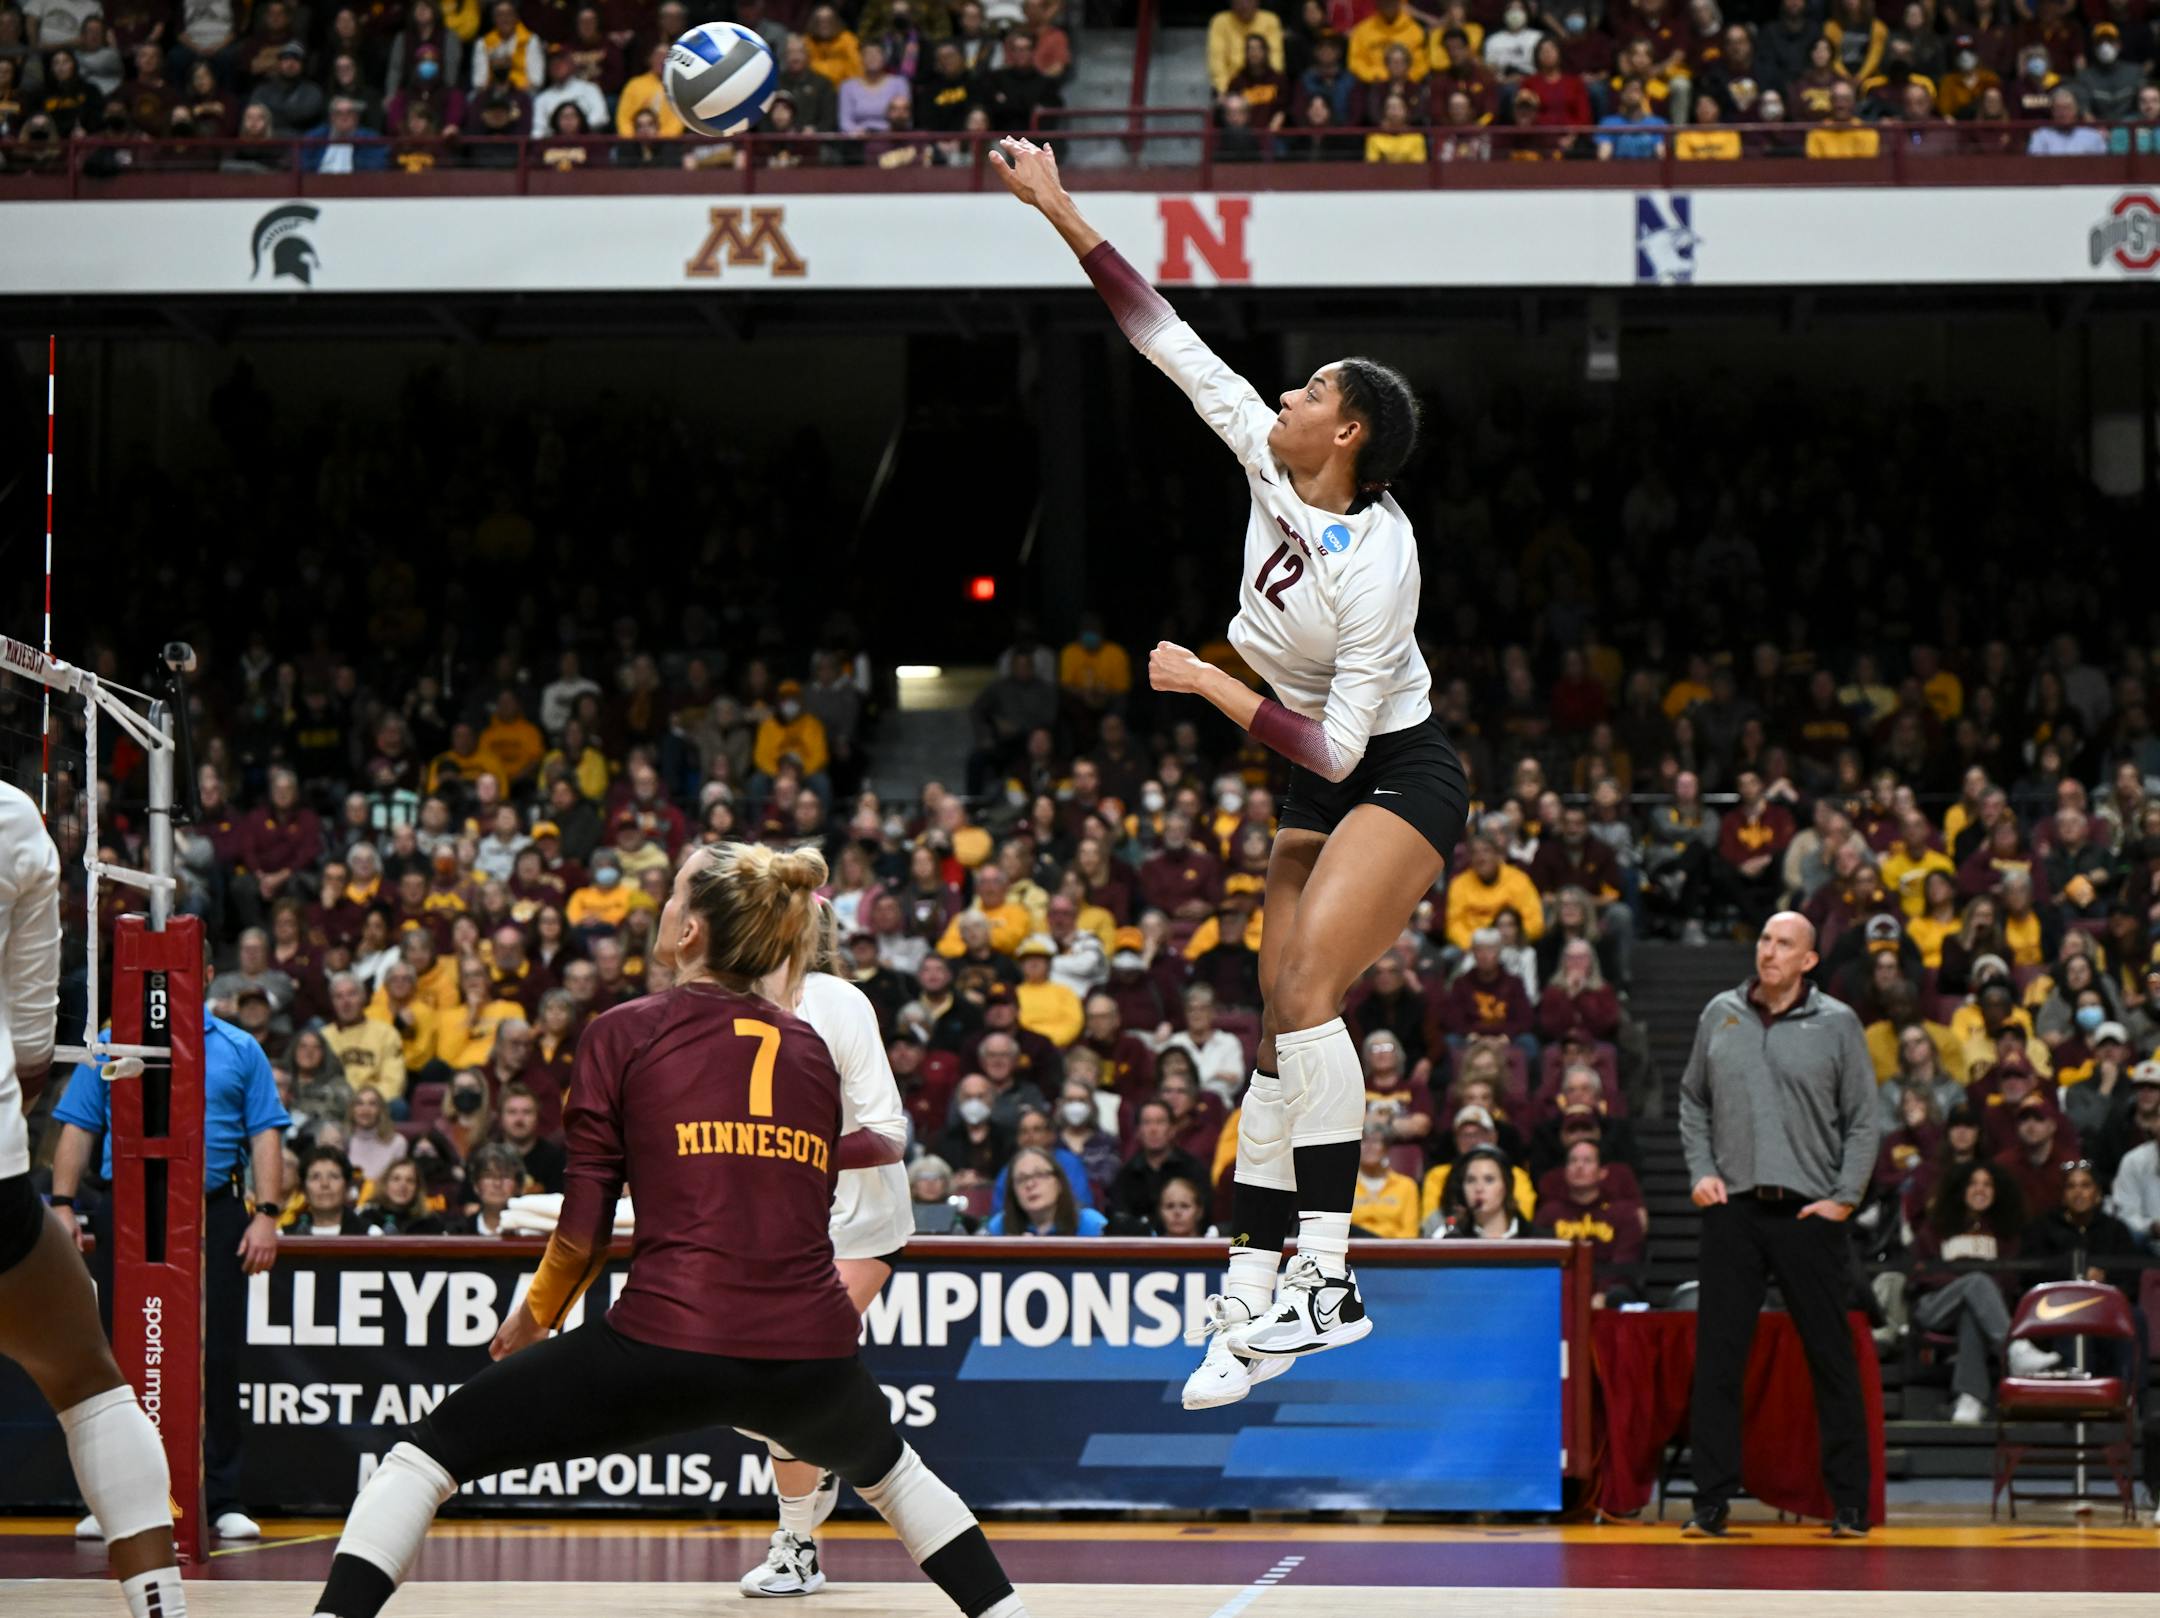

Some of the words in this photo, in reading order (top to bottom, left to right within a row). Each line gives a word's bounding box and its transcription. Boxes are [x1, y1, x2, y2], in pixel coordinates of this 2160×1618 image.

[1157, 196, 1251, 282] N
[1254, 540, 1304, 612] 12
[733, 1018, 781, 1117] 7
[142, 1296, 164, 1365] sports
[141, 1368, 163, 1440] impo
[371, 1384, 464, 1425] AN
